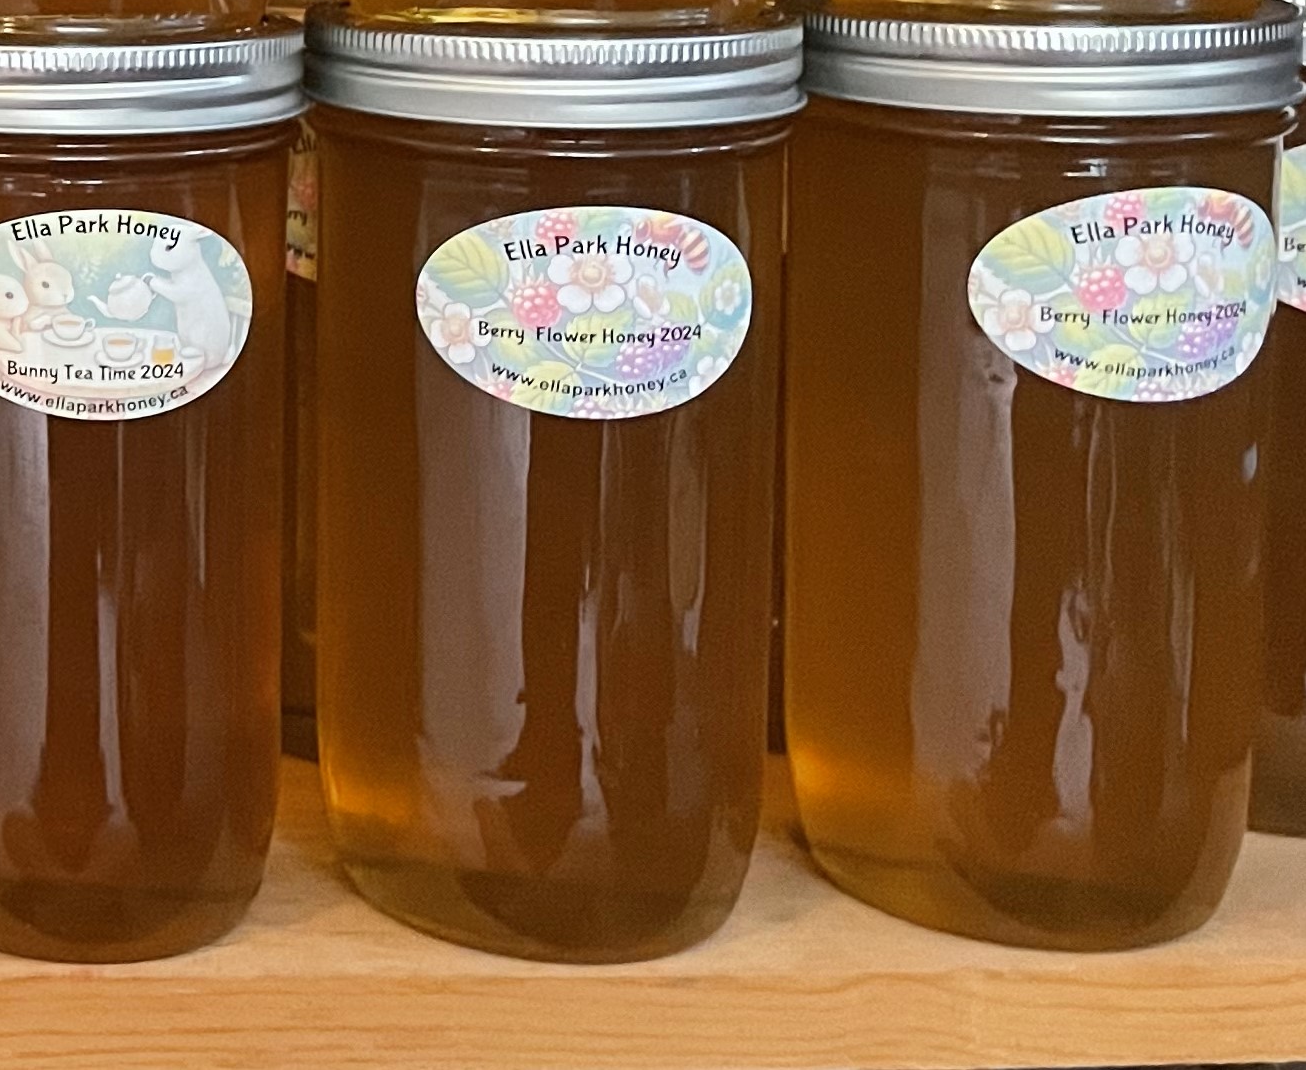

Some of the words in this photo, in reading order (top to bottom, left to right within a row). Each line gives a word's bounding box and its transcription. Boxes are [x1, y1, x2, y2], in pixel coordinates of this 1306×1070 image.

[11, 219, 52, 242] Ella
[58, 214, 108, 236] Park
[117, 215, 181, 249] Honey
[1071, 222, 1115, 245] Ella
[1123, 216, 1173, 237] Park
[1181, 214, 1234, 245] Honey
[504, 239, 547, 262] Ella
[555, 235, 607, 255] Park
[617, 237, 681, 271] Honey
[1041, 306, 1090, 327] Berry
[1102, 309, 1161, 326] Flower
[1166, 309, 1212, 325] Honey
[1215, 300, 1247, 321] 2024
[478, 321, 524, 343] Berry
[536, 327, 596, 344] Flower
[603, 329, 655, 347] Honey
[660, 325, 702, 343] 2024
[7, 361, 58, 384] Bunny
[64, 365, 93, 380] Tea
[100, 365, 135, 381] Time
[141, 362, 184, 380] 2024
[1054, 346, 1235, 380] www.ellaparkhoney.ca
[492, 362, 688, 399] www.ellaparkhoney.ca
[0, 380, 189, 417] www.ellaparkhoney.ca
